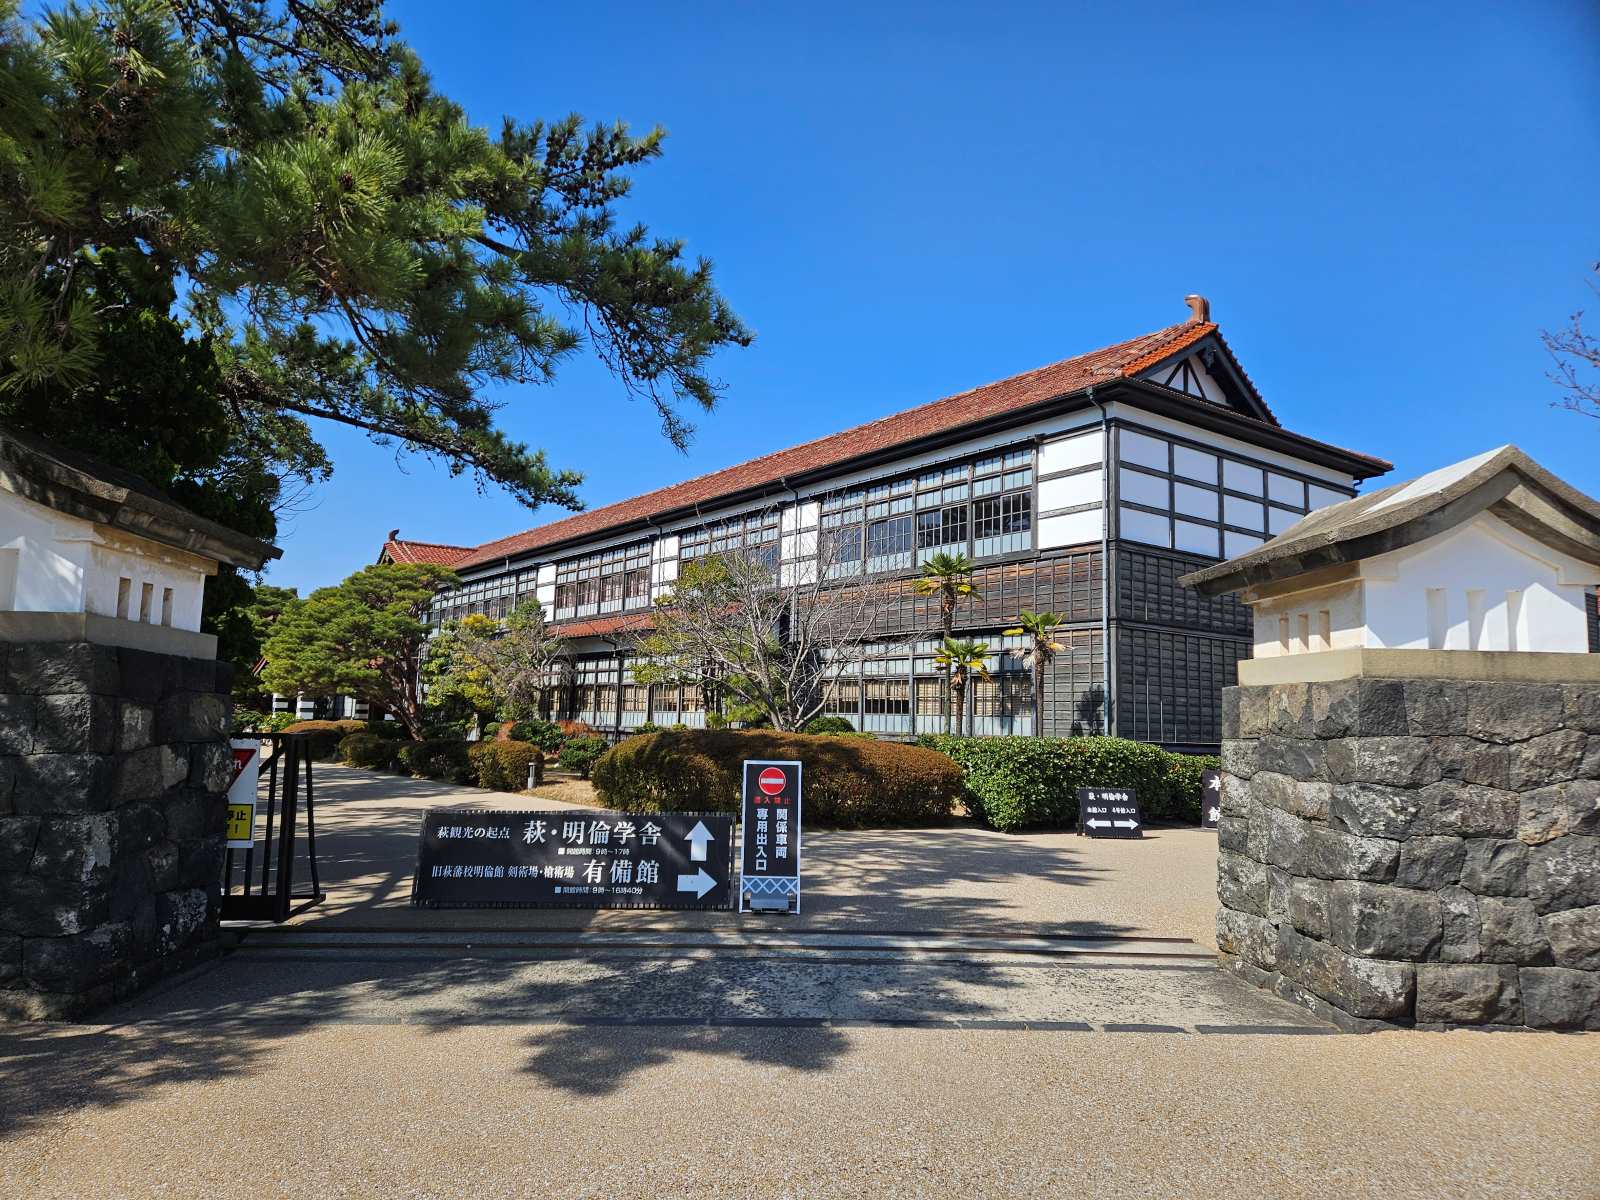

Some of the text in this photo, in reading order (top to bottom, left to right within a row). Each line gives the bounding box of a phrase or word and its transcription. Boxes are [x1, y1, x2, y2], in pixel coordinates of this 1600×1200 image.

[437, 819, 663, 846] 萩観光の起点 萩・明倫学舎
[756, 809, 768, 870] 専用出入口
[776, 809, 787, 858] 関係車両
[431, 858, 661, 884] 旧萩藩校明倫館 剣術場・槍術場 有備館
